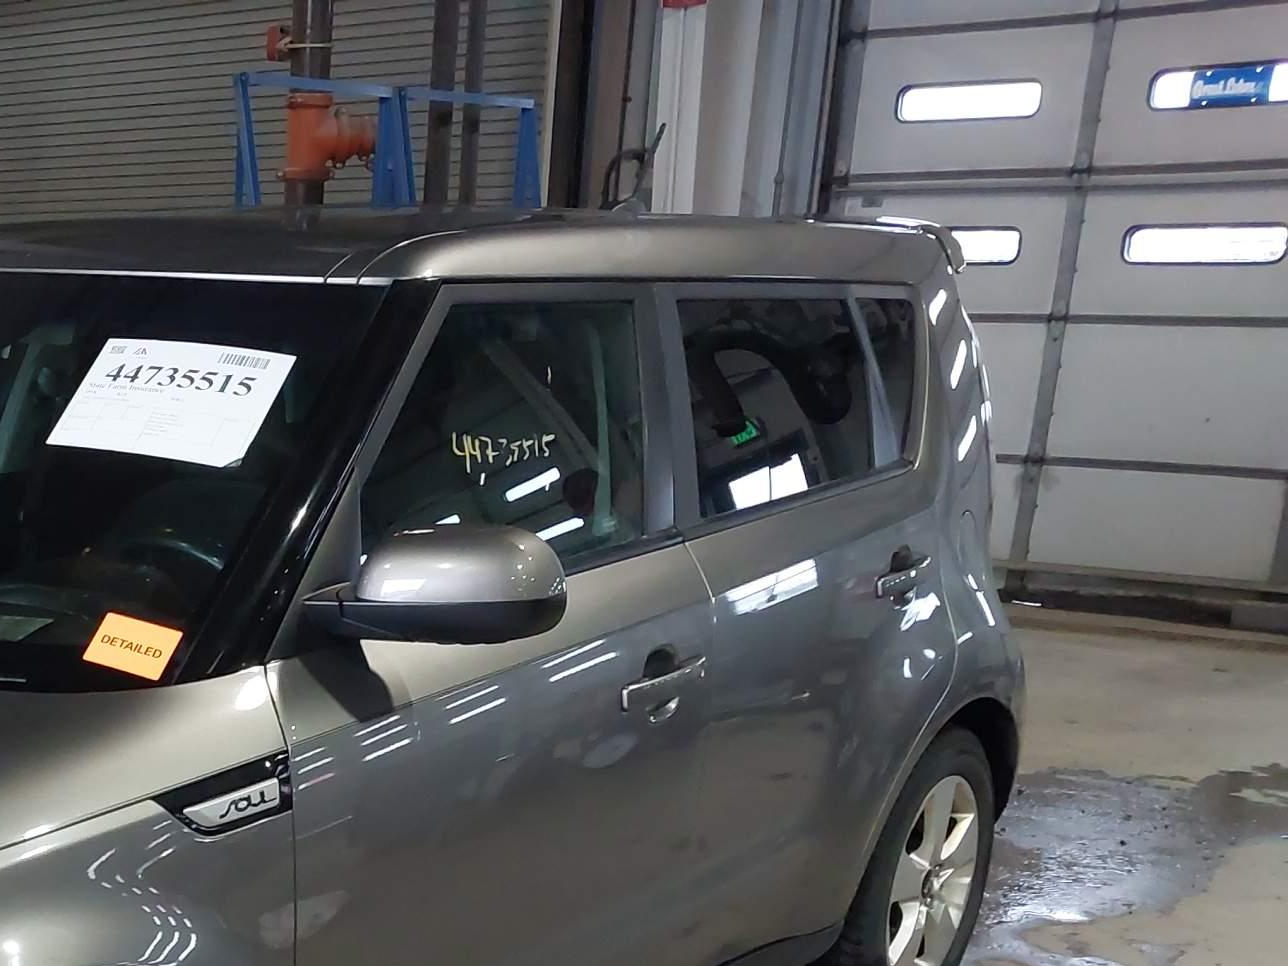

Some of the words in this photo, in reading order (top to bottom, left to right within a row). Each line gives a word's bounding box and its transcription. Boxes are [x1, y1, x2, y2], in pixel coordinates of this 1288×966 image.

[104, 363, 258, 397] 44735515
[452, 432, 556, 473] 44735515
[100, 634, 163, 659] DETAILED
